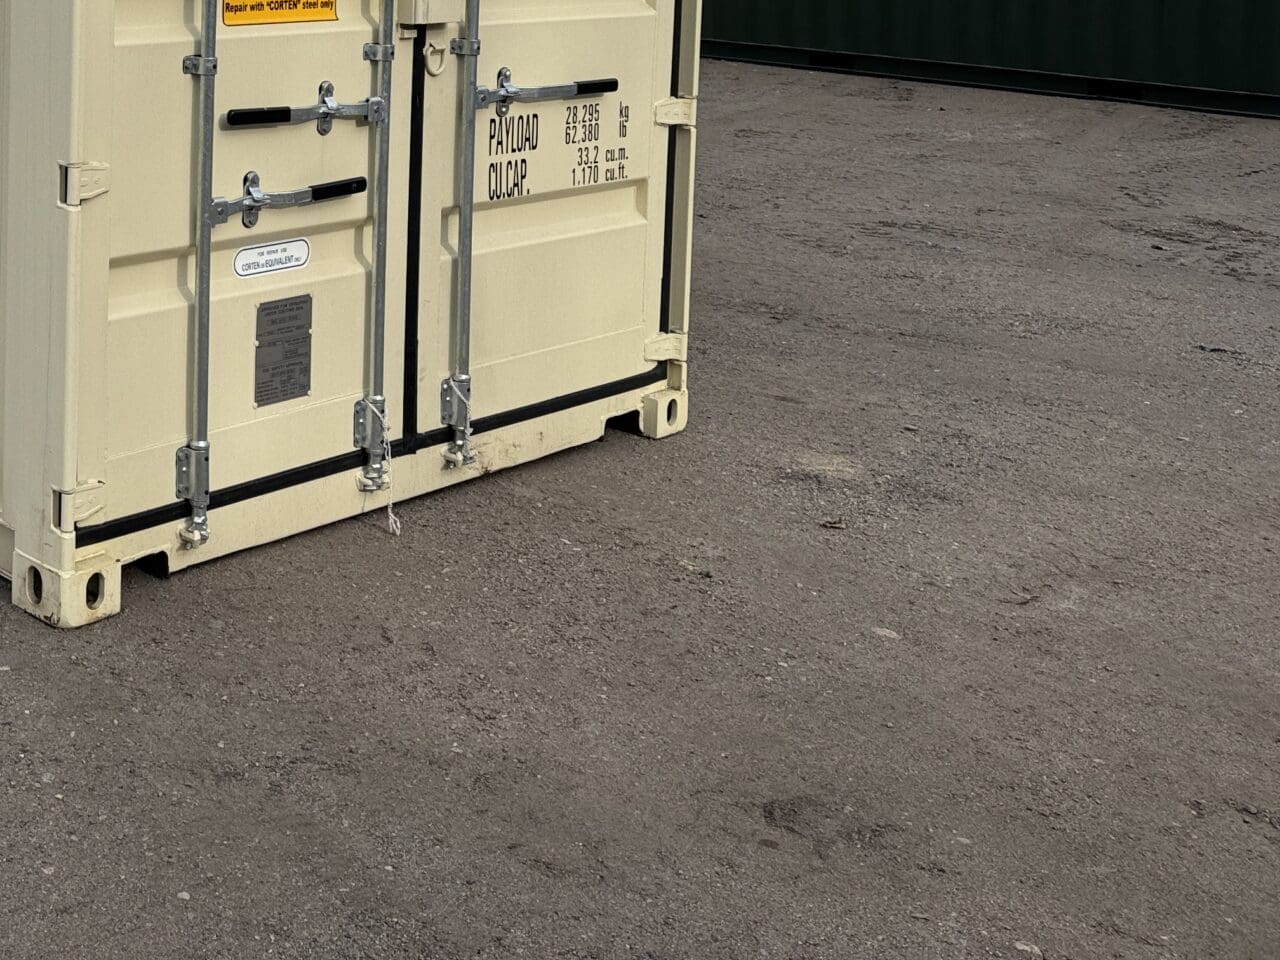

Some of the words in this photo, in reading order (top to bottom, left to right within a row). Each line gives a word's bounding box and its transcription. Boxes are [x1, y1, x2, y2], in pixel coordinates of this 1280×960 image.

[225, 2, 248, 15] Repair
[249, 1, 264, 11] with
[566, 103, 600, 125] 28,295
[619, 101, 629, 122] kg
[489, 113, 538, 156] PAYLOAD
[565, 123, 599, 144] 62,380
[619, 120, 627, 138] lb
[577, 145, 599, 166] 33.2
[605, 147, 629, 162] cu.m.
[488, 159, 530, 201] CU.CAP.
[605, 162, 628, 181] cu.ft.
[241, 261, 260, 272] CORTEN
[265, 255, 294, 268] EQUIVALENT
